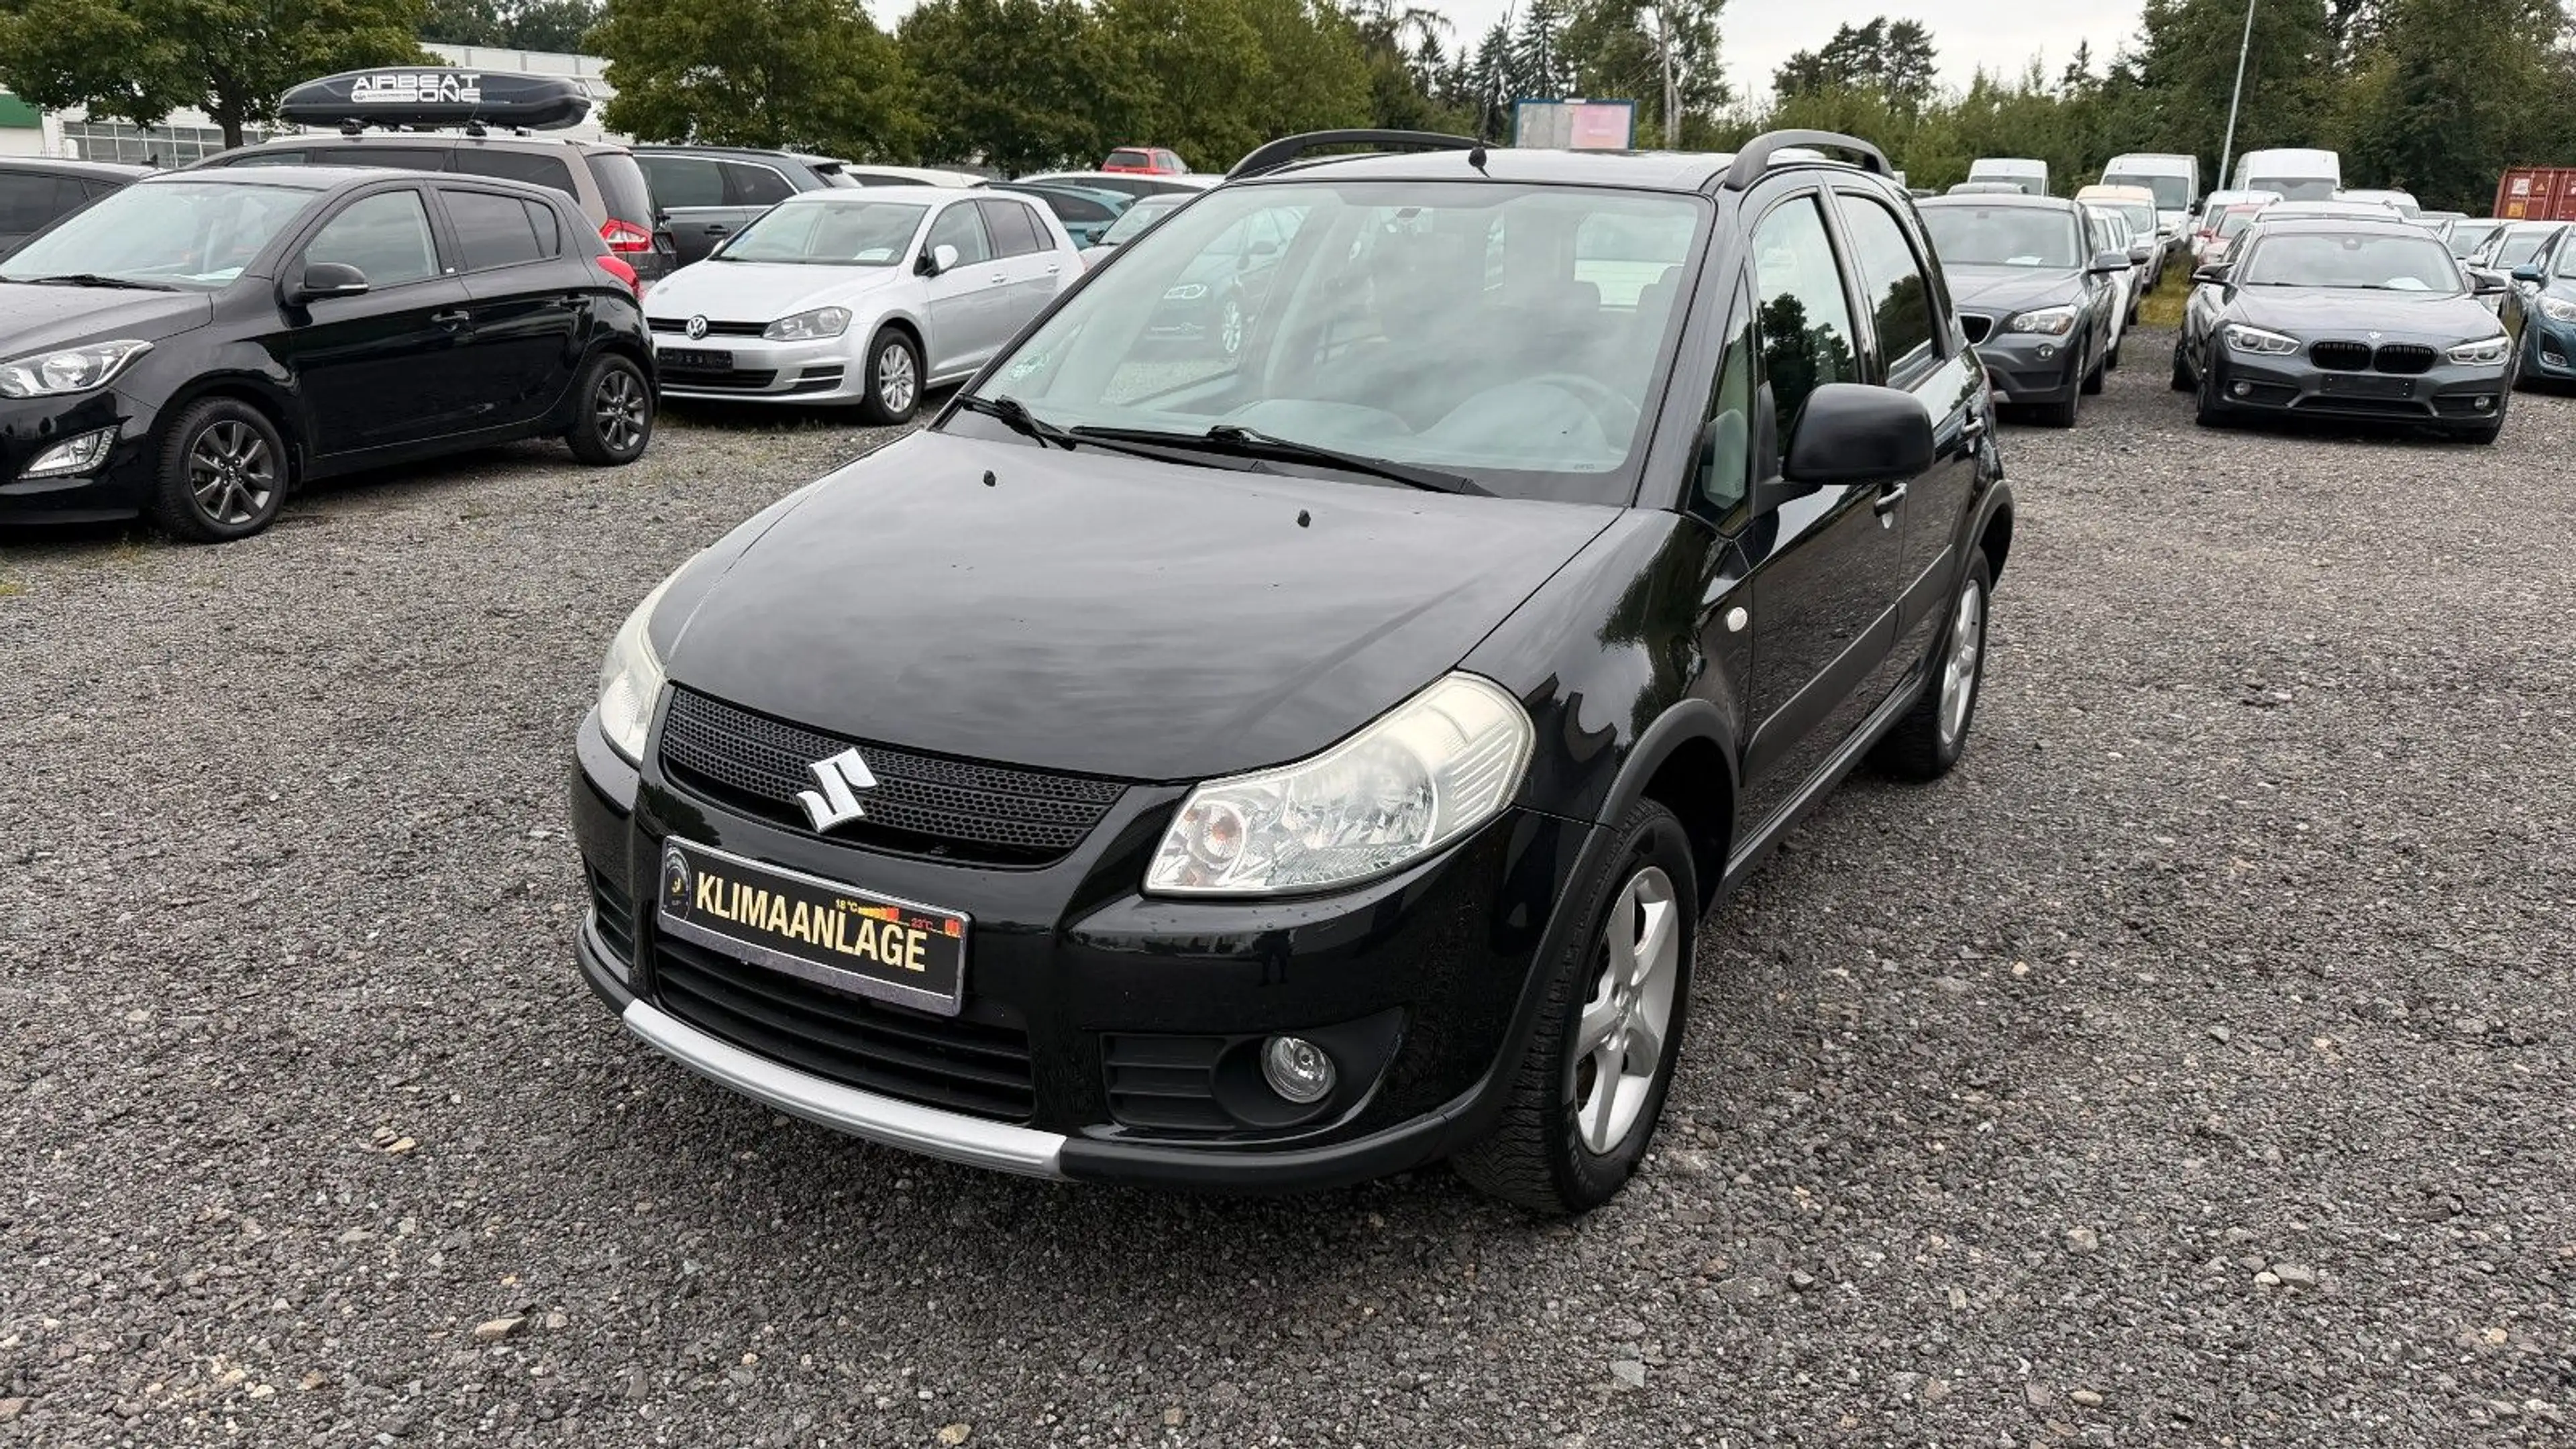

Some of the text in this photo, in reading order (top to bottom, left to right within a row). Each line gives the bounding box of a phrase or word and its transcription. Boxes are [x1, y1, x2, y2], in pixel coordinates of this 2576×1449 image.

[353, 74, 480, 90] AIRBEAT
[418, 88, 480, 103] ONE
[696, 872, 927, 972] KLIMAANLAGE
